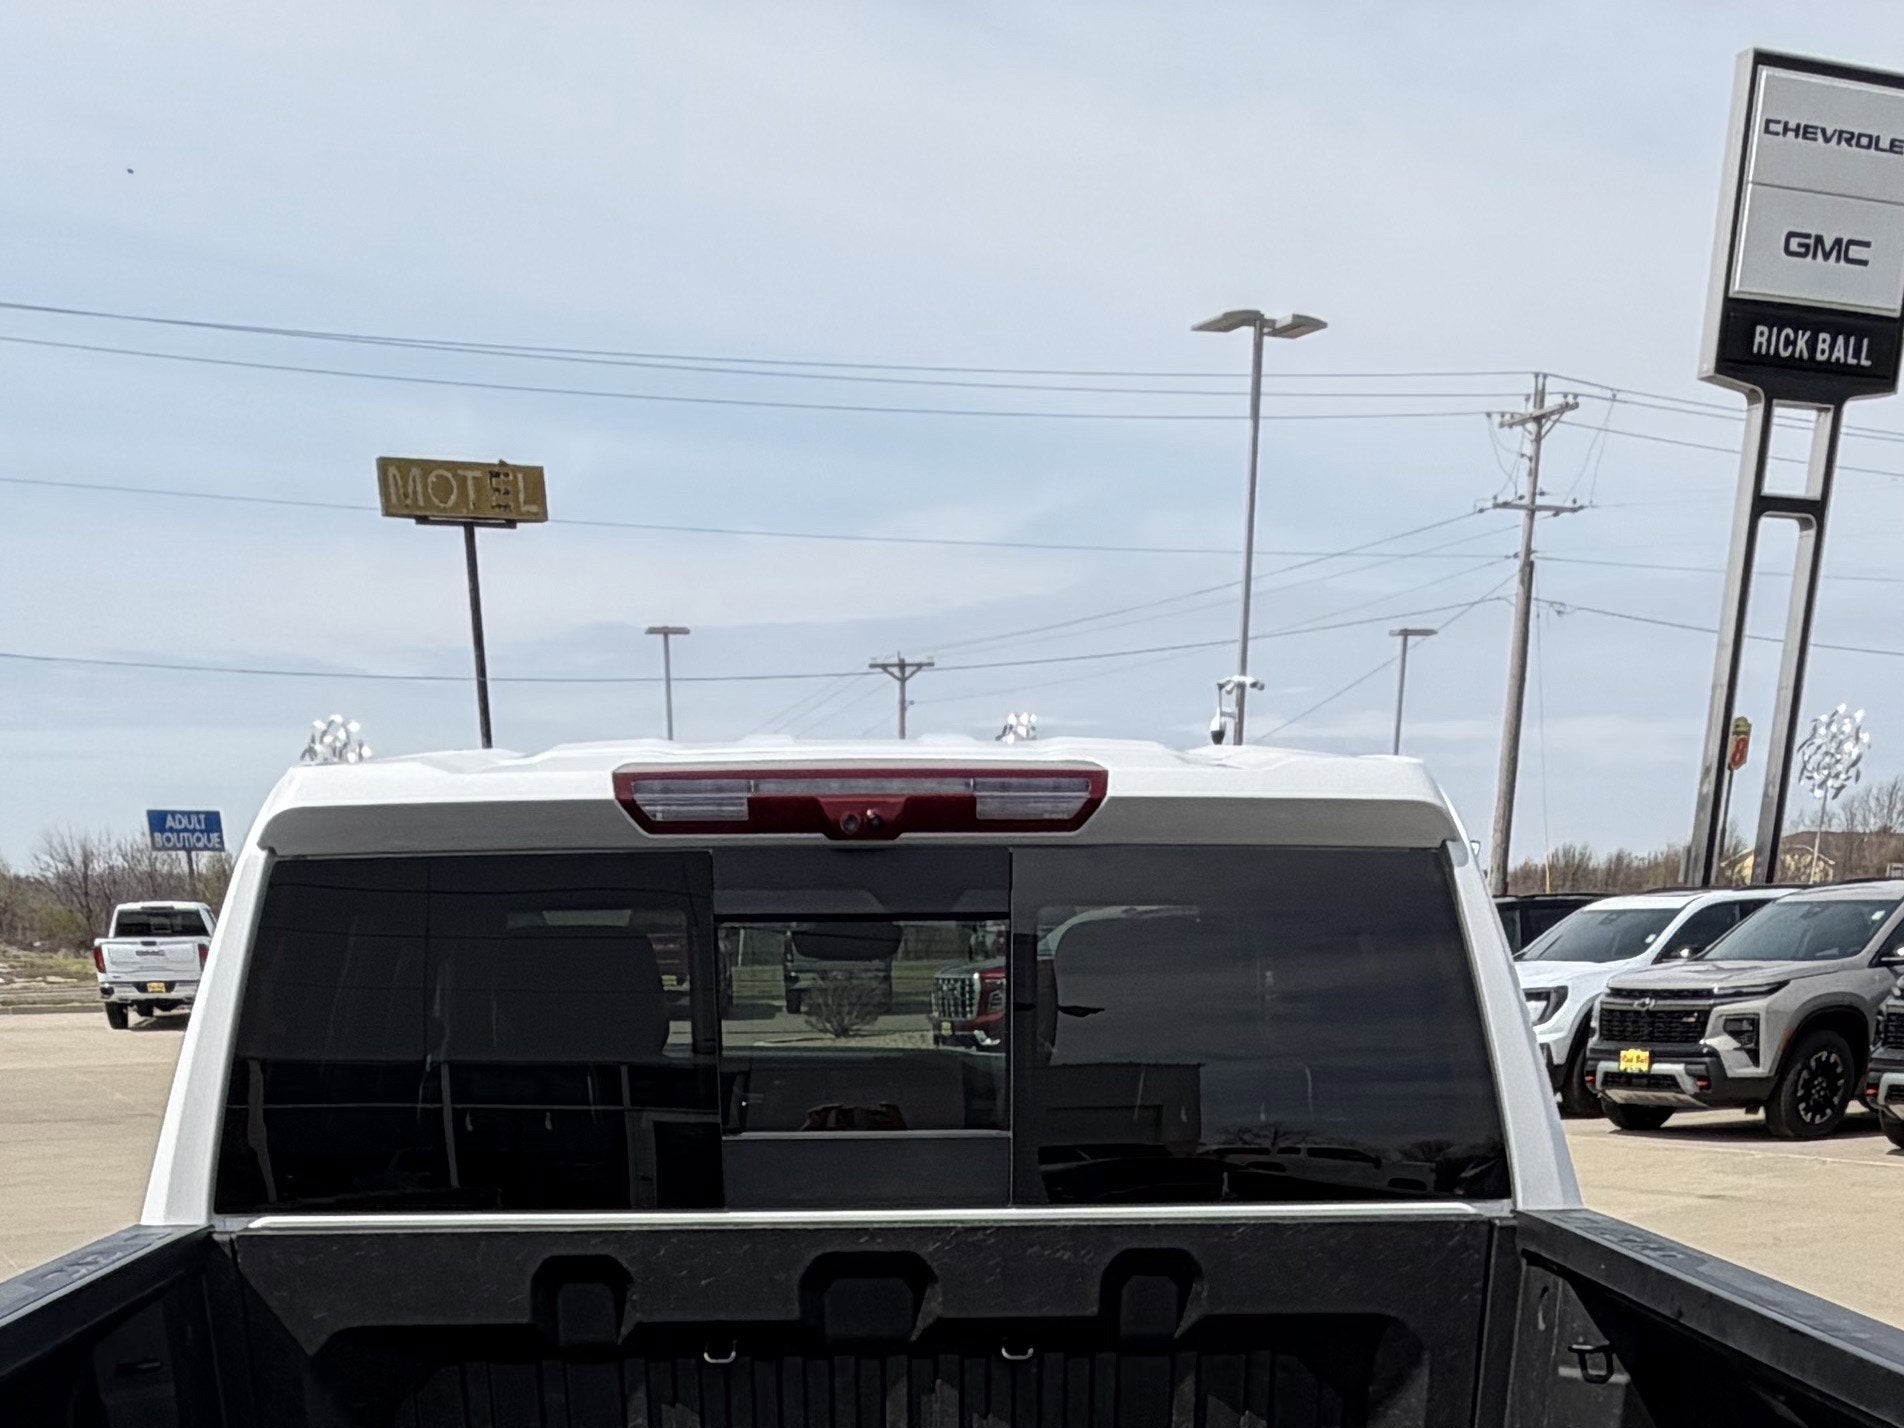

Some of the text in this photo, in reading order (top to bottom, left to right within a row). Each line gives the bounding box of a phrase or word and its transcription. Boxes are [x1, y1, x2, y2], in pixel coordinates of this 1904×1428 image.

[1783, 230, 1872, 267] GMC
[1752, 324, 1873, 367] RICK BALL
[386, 465, 540, 513] MOTEL
[165, 813, 207, 829] ADULT
[153, 832, 222, 849] BOUTIQUE
